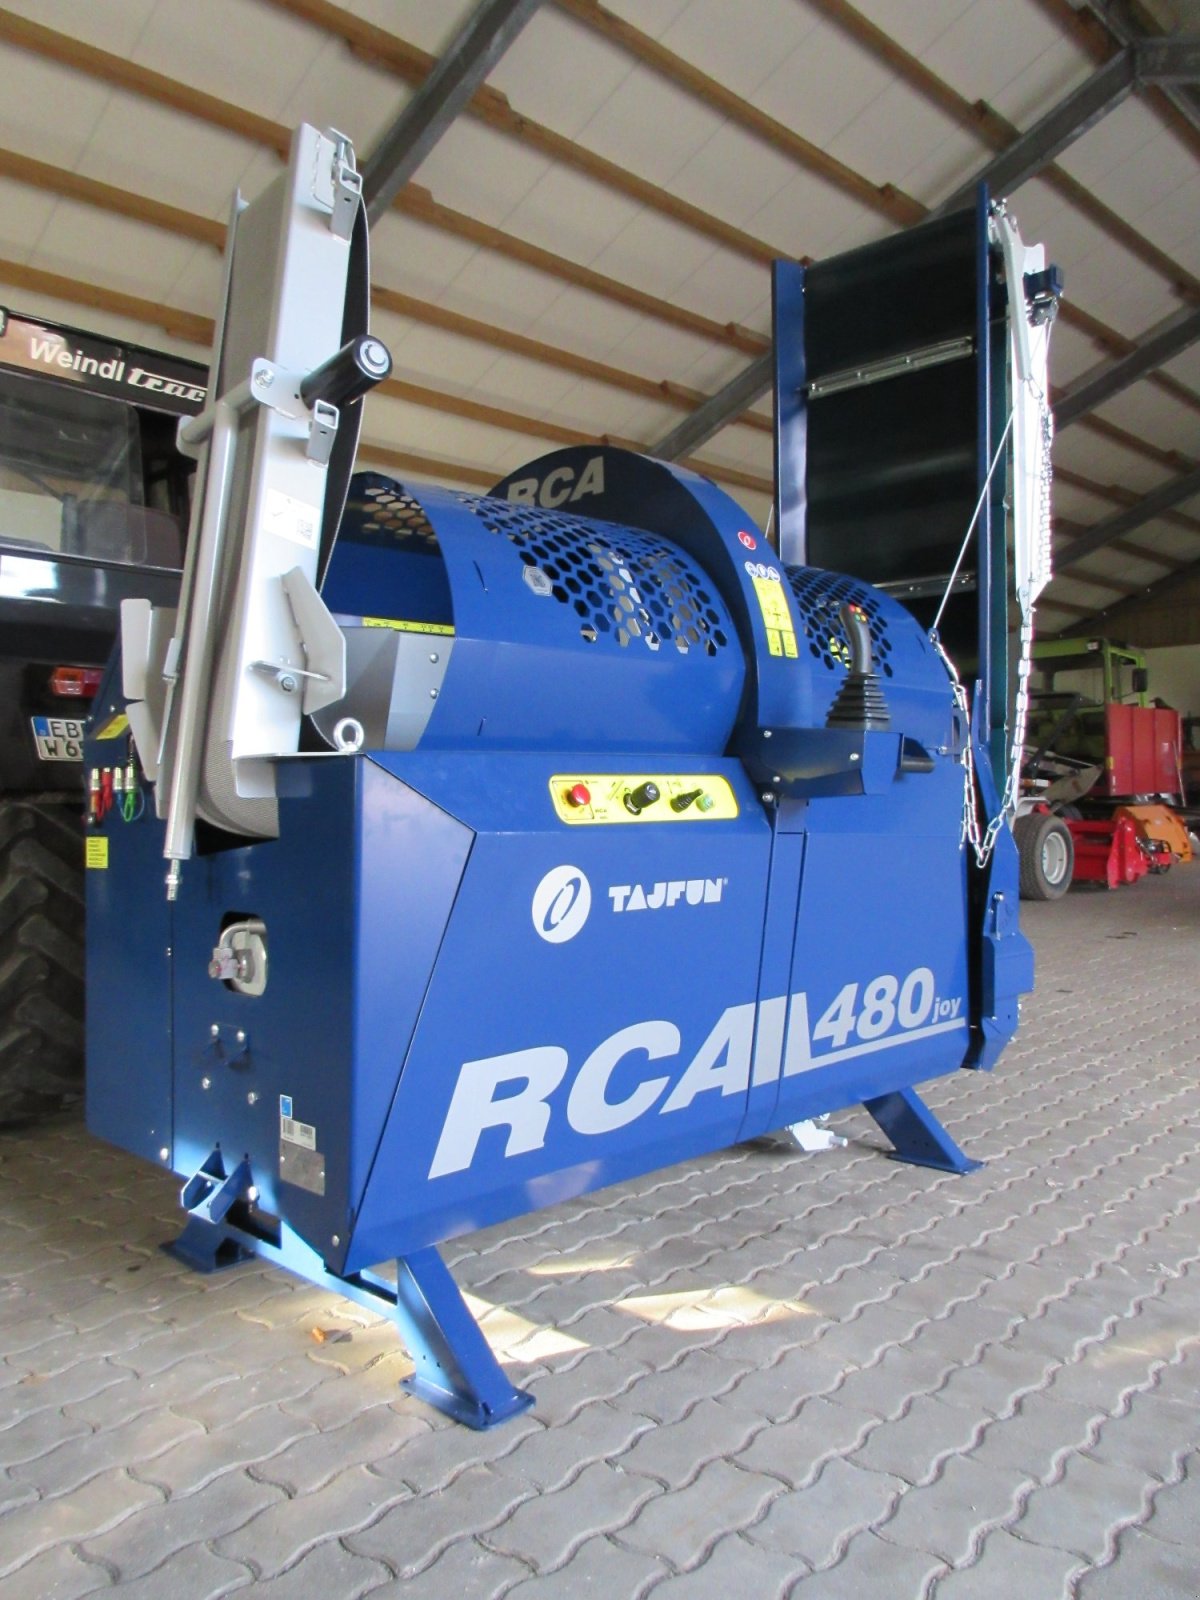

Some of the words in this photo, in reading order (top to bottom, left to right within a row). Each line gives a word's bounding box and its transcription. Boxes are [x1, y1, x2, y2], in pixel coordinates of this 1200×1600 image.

[30, 337, 125, 382] Weindl
[507, 455, 605, 508] RCA
[50, 721, 85, 738] EB
[812, 967, 935, 1048] 480
[931, 997, 962, 1024] joy
